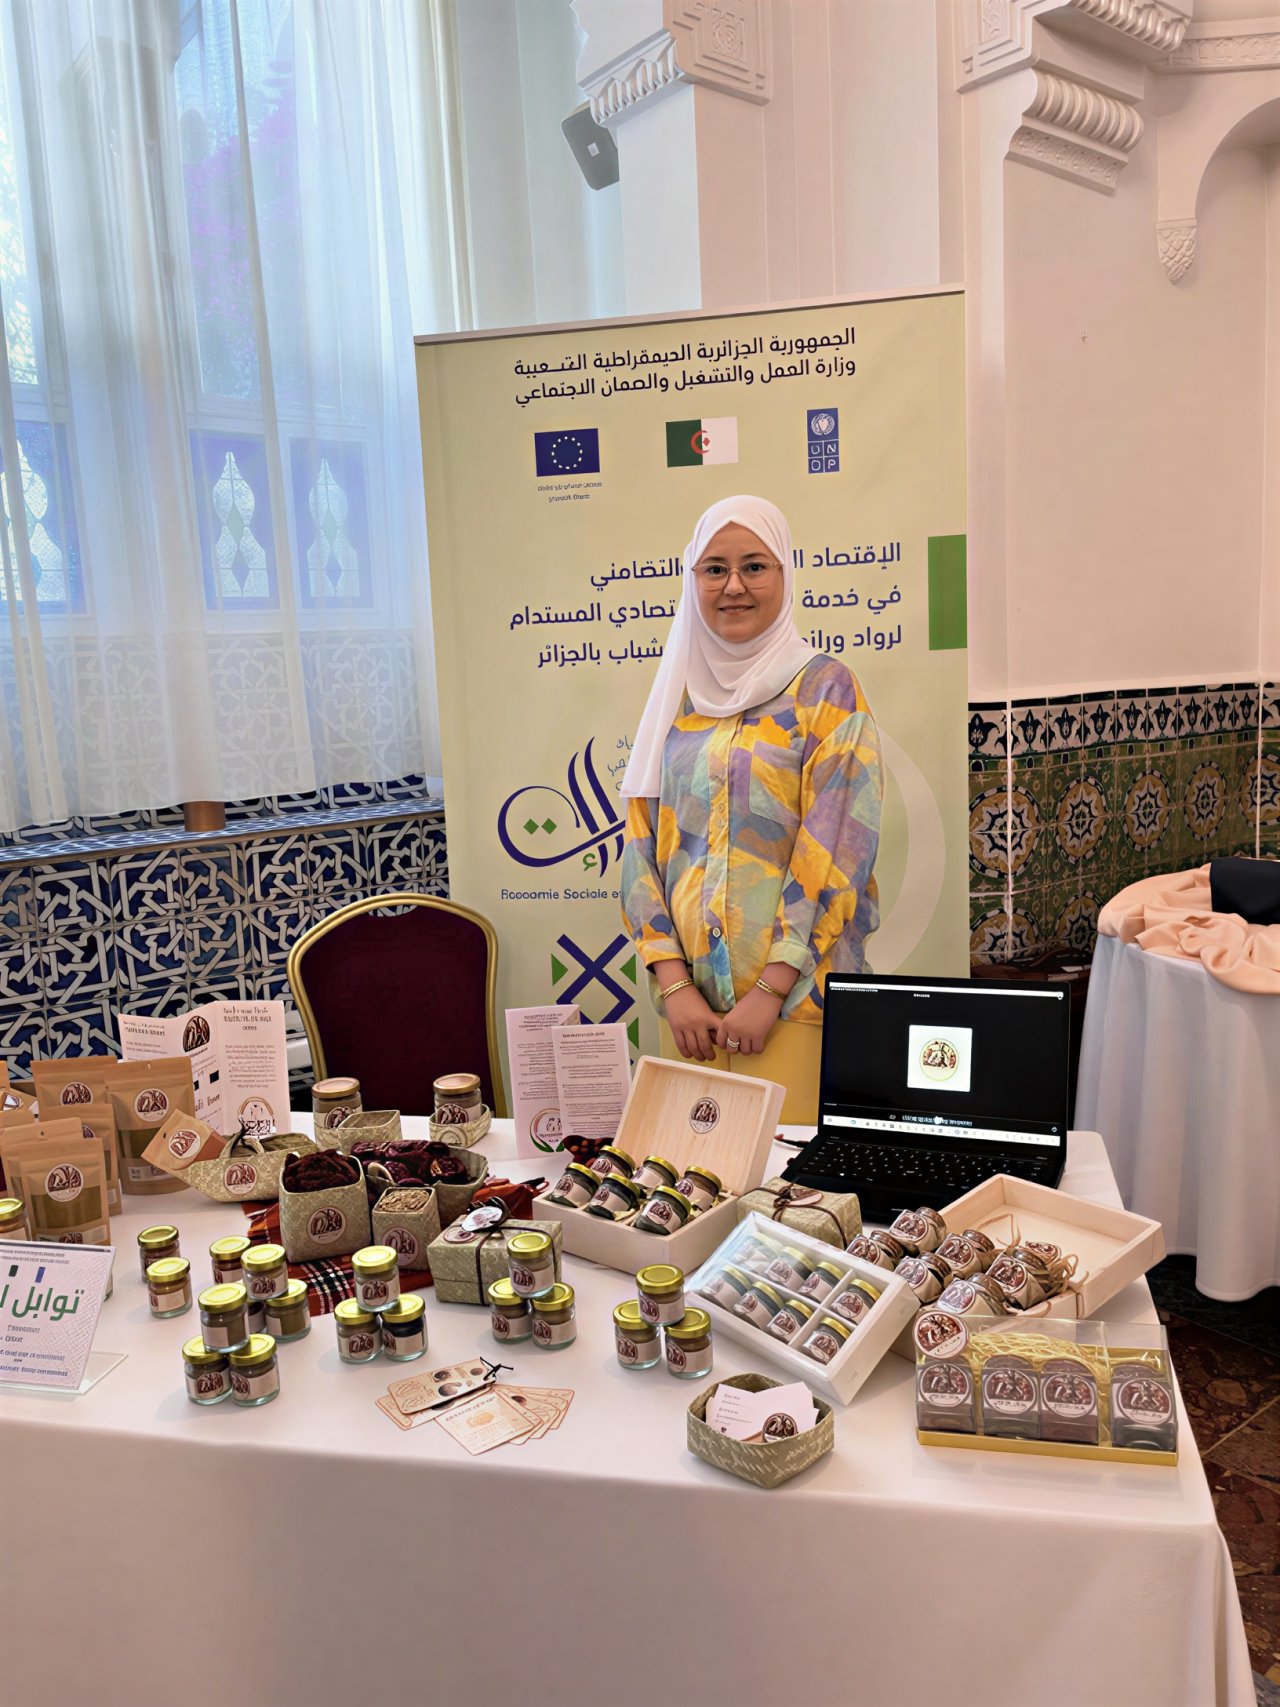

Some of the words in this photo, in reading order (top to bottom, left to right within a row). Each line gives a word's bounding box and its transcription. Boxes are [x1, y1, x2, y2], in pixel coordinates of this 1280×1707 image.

[760, 359, 810, 384] العمل
[815, 356, 856, 378] وزارة
[802, 588, 859, 608] خدمة
[867, 584, 901, 615] في
[509, 602, 601, 630] المستدام
[852, 624, 901, 651] لرواد
[11, 1286, 85, 1321] توابل
